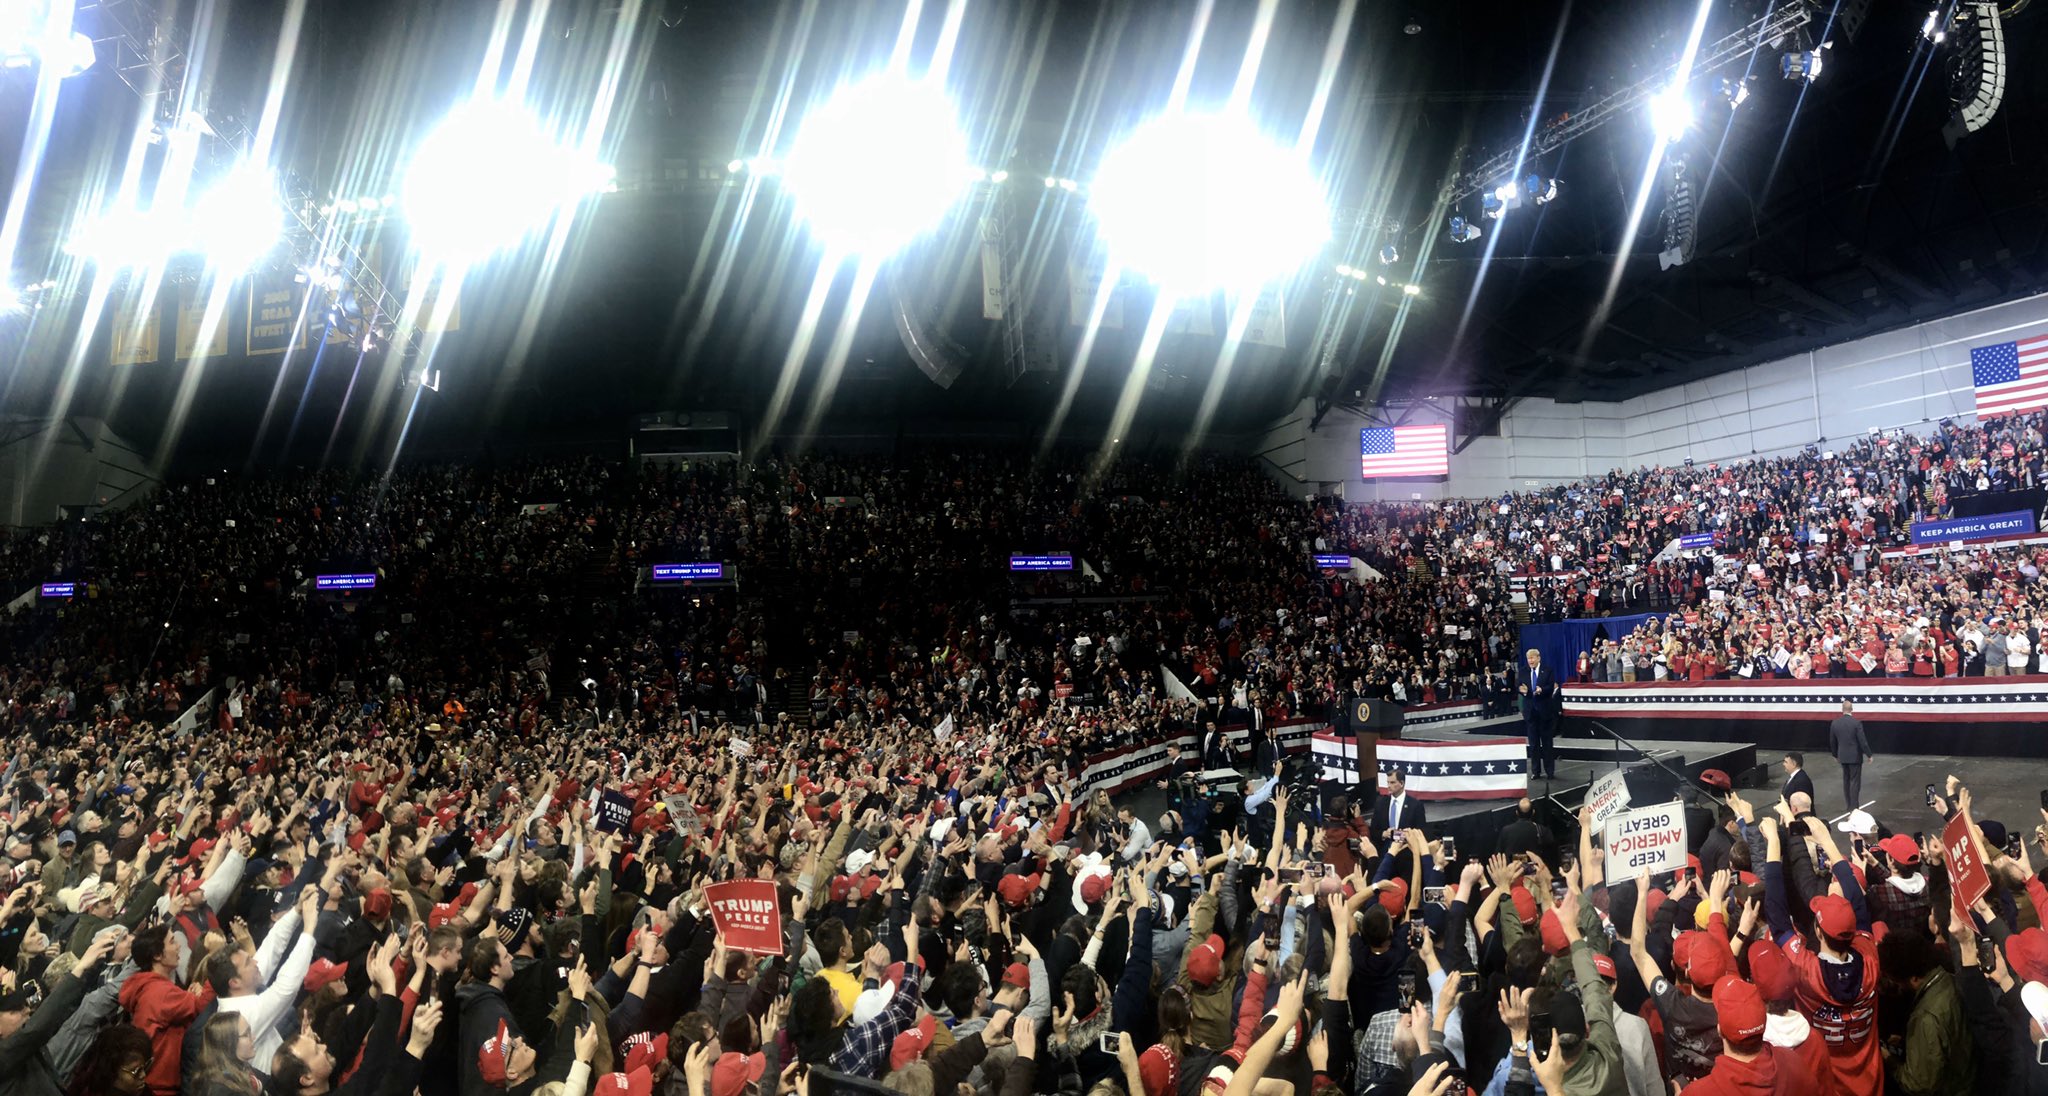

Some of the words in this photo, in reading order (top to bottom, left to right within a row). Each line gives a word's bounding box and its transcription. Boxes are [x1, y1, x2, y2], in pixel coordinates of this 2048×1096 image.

[1920, 529, 1943, 538] KEEP
[1945, 524, 1986, 535] AMERICA
[1988, 519, 2023, 530] GREAT!
[1592, 779, 1613, 798] KEEP
[604, 801, 631, 817] TRUMP
[1619, 814, 1670, 836] GREAT!
[1610, 828, 1682, 856] AMERICA
[1629, 850, 1666, 867] KEEP
[713, 898, 774, 914] TRUMP
[724, 912, 770, 925] PENCE
